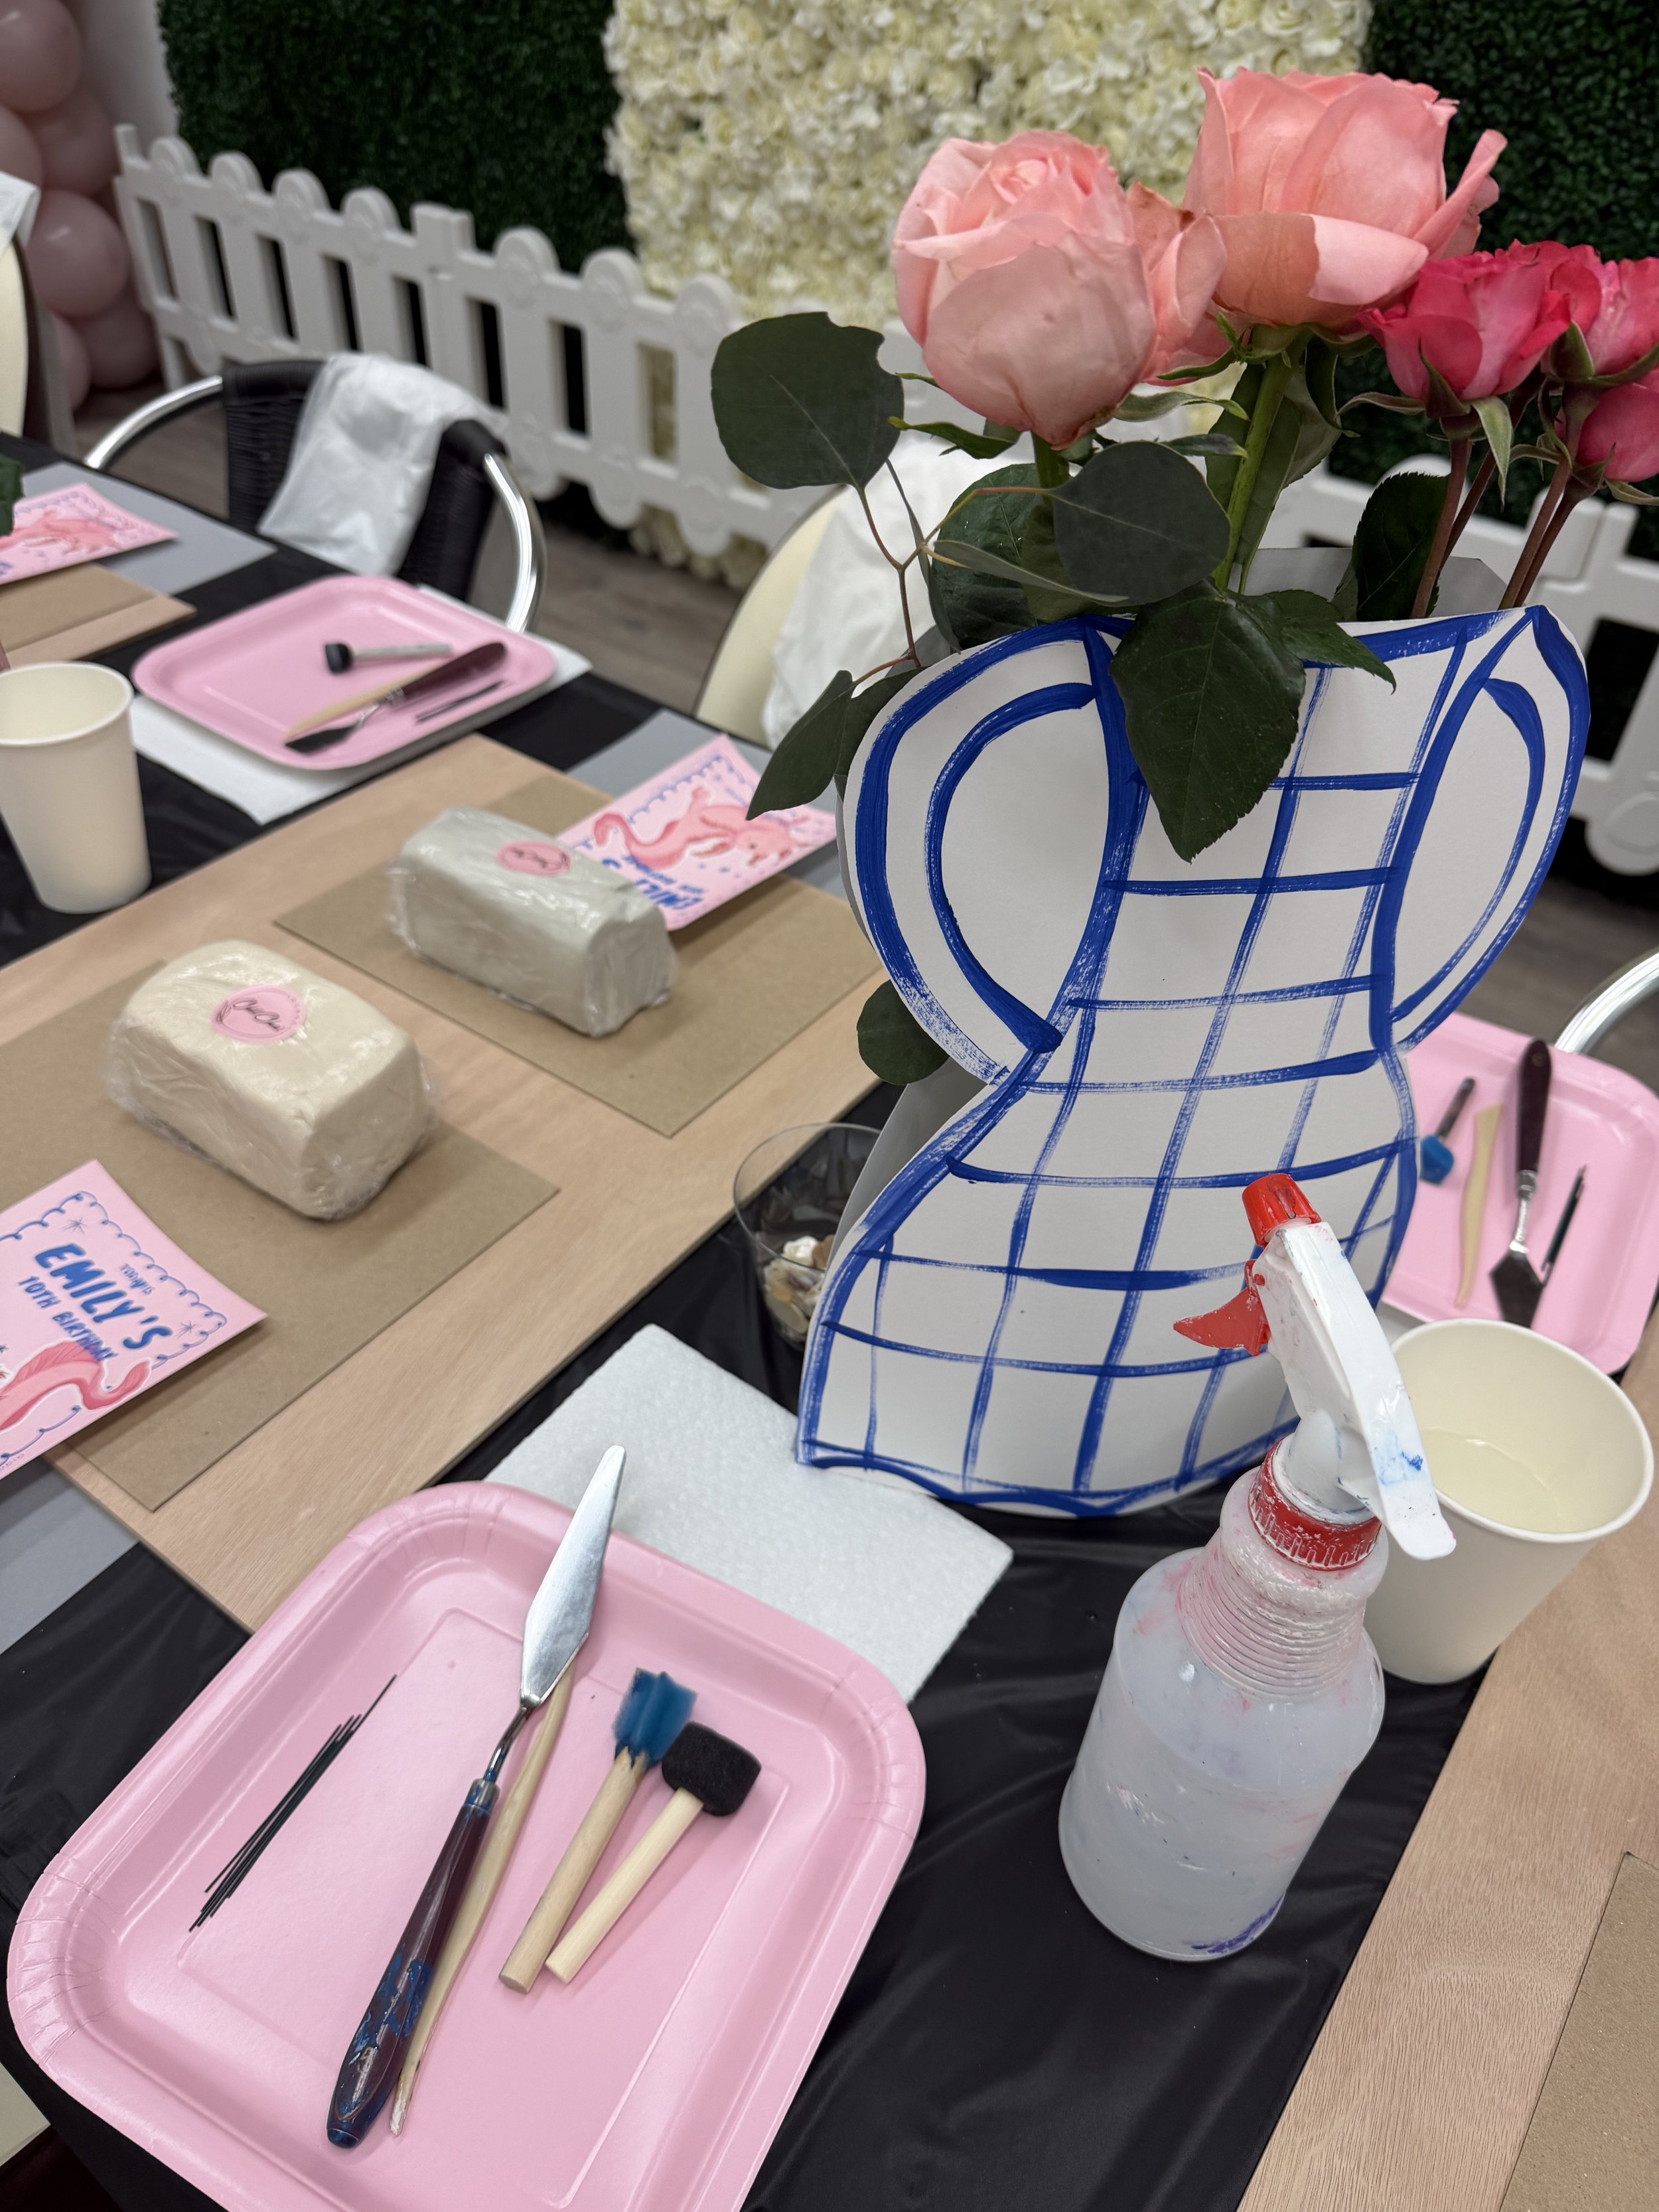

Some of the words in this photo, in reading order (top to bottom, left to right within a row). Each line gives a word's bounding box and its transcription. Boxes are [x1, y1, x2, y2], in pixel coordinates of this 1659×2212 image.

[18, 1276, 61, 1309] 10TH
[52, 1311, 119, 1362] BIRTHDAY
[35, 1242, 173, 1349] EMILY'S
